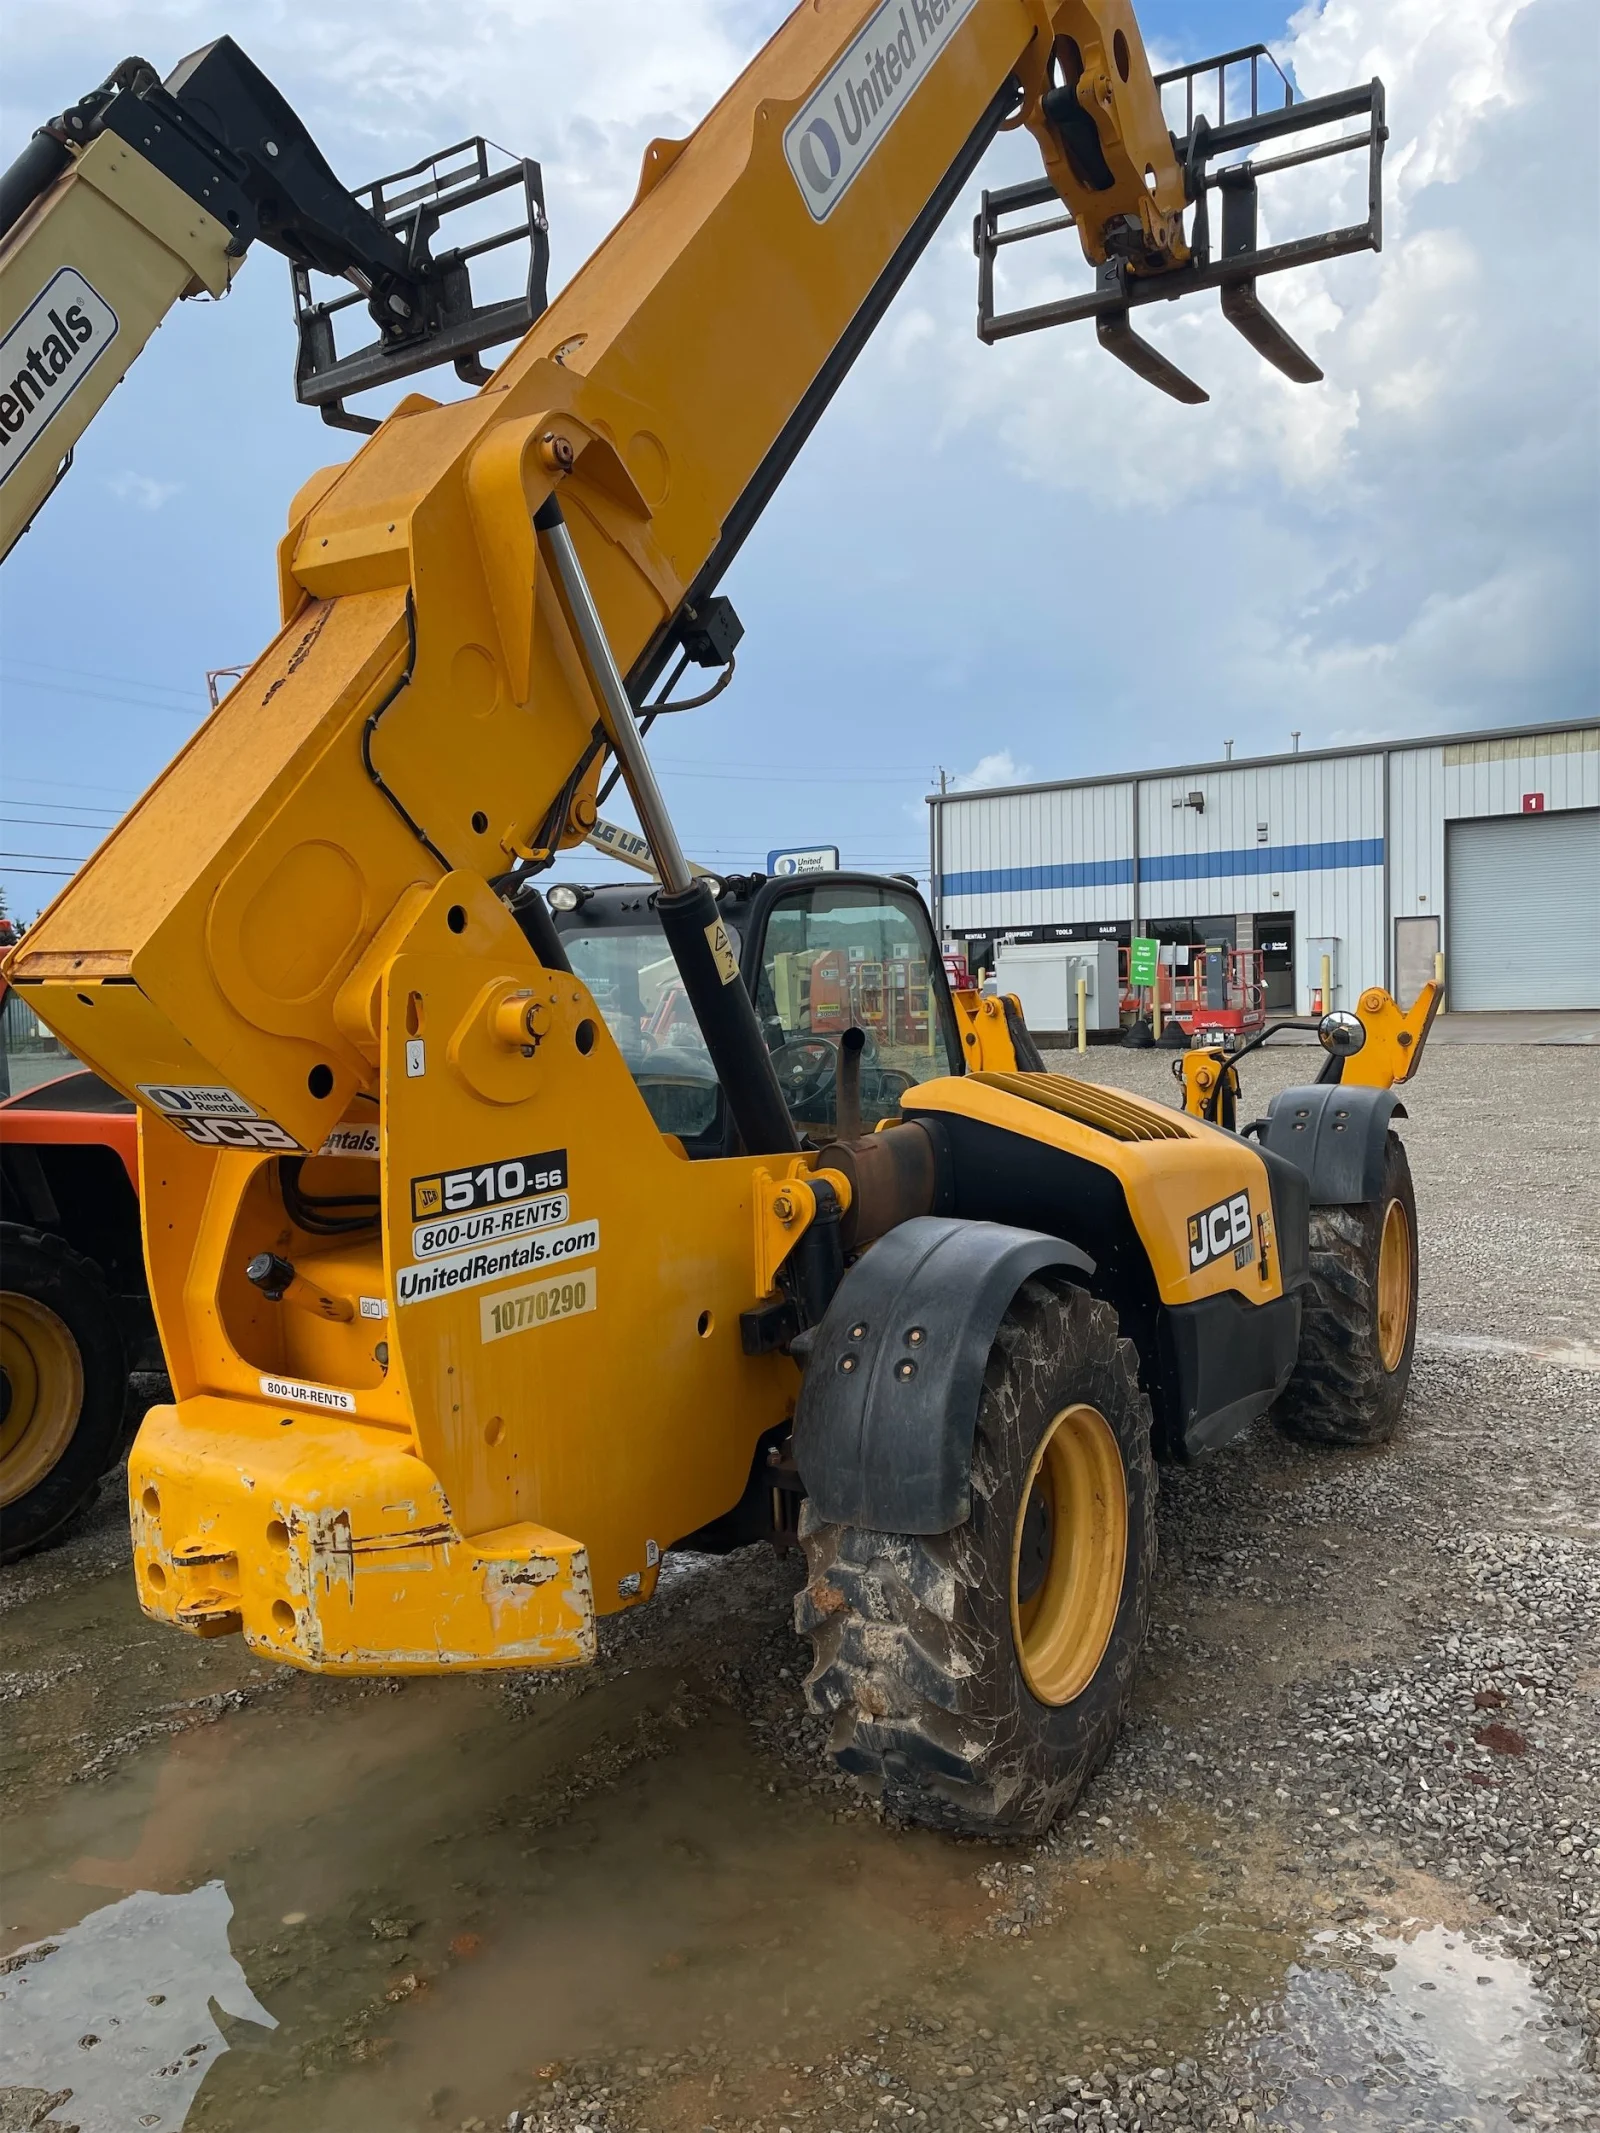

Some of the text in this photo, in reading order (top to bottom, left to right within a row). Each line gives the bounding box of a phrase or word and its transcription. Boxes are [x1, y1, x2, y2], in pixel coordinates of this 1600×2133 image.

[834, 7, 917, 146] United
[1529, 798, 1537, 809] 1
[592, 820, 618, 844] LG
[798, 856, 822, 866] United
[798, 865, 824, 874] Rentals
[181, 1090, 233, 1103] United
[193, 1101, 250, 1114] Rentals
[185, 1118, 299, 1149] JCB
[419, 1161, 562, 1210] JCB 510-56
[421, 1200, 562, 1251] 800-UR-RENTS
[1190, 1194, 1251, 1267] JCB
[400, 1230, 596, 1299] UnitedRentals.com
[491, 1281, 586, 1334] 10770290
[267, 1382, 348, 1408] 800-UR-RENTS
